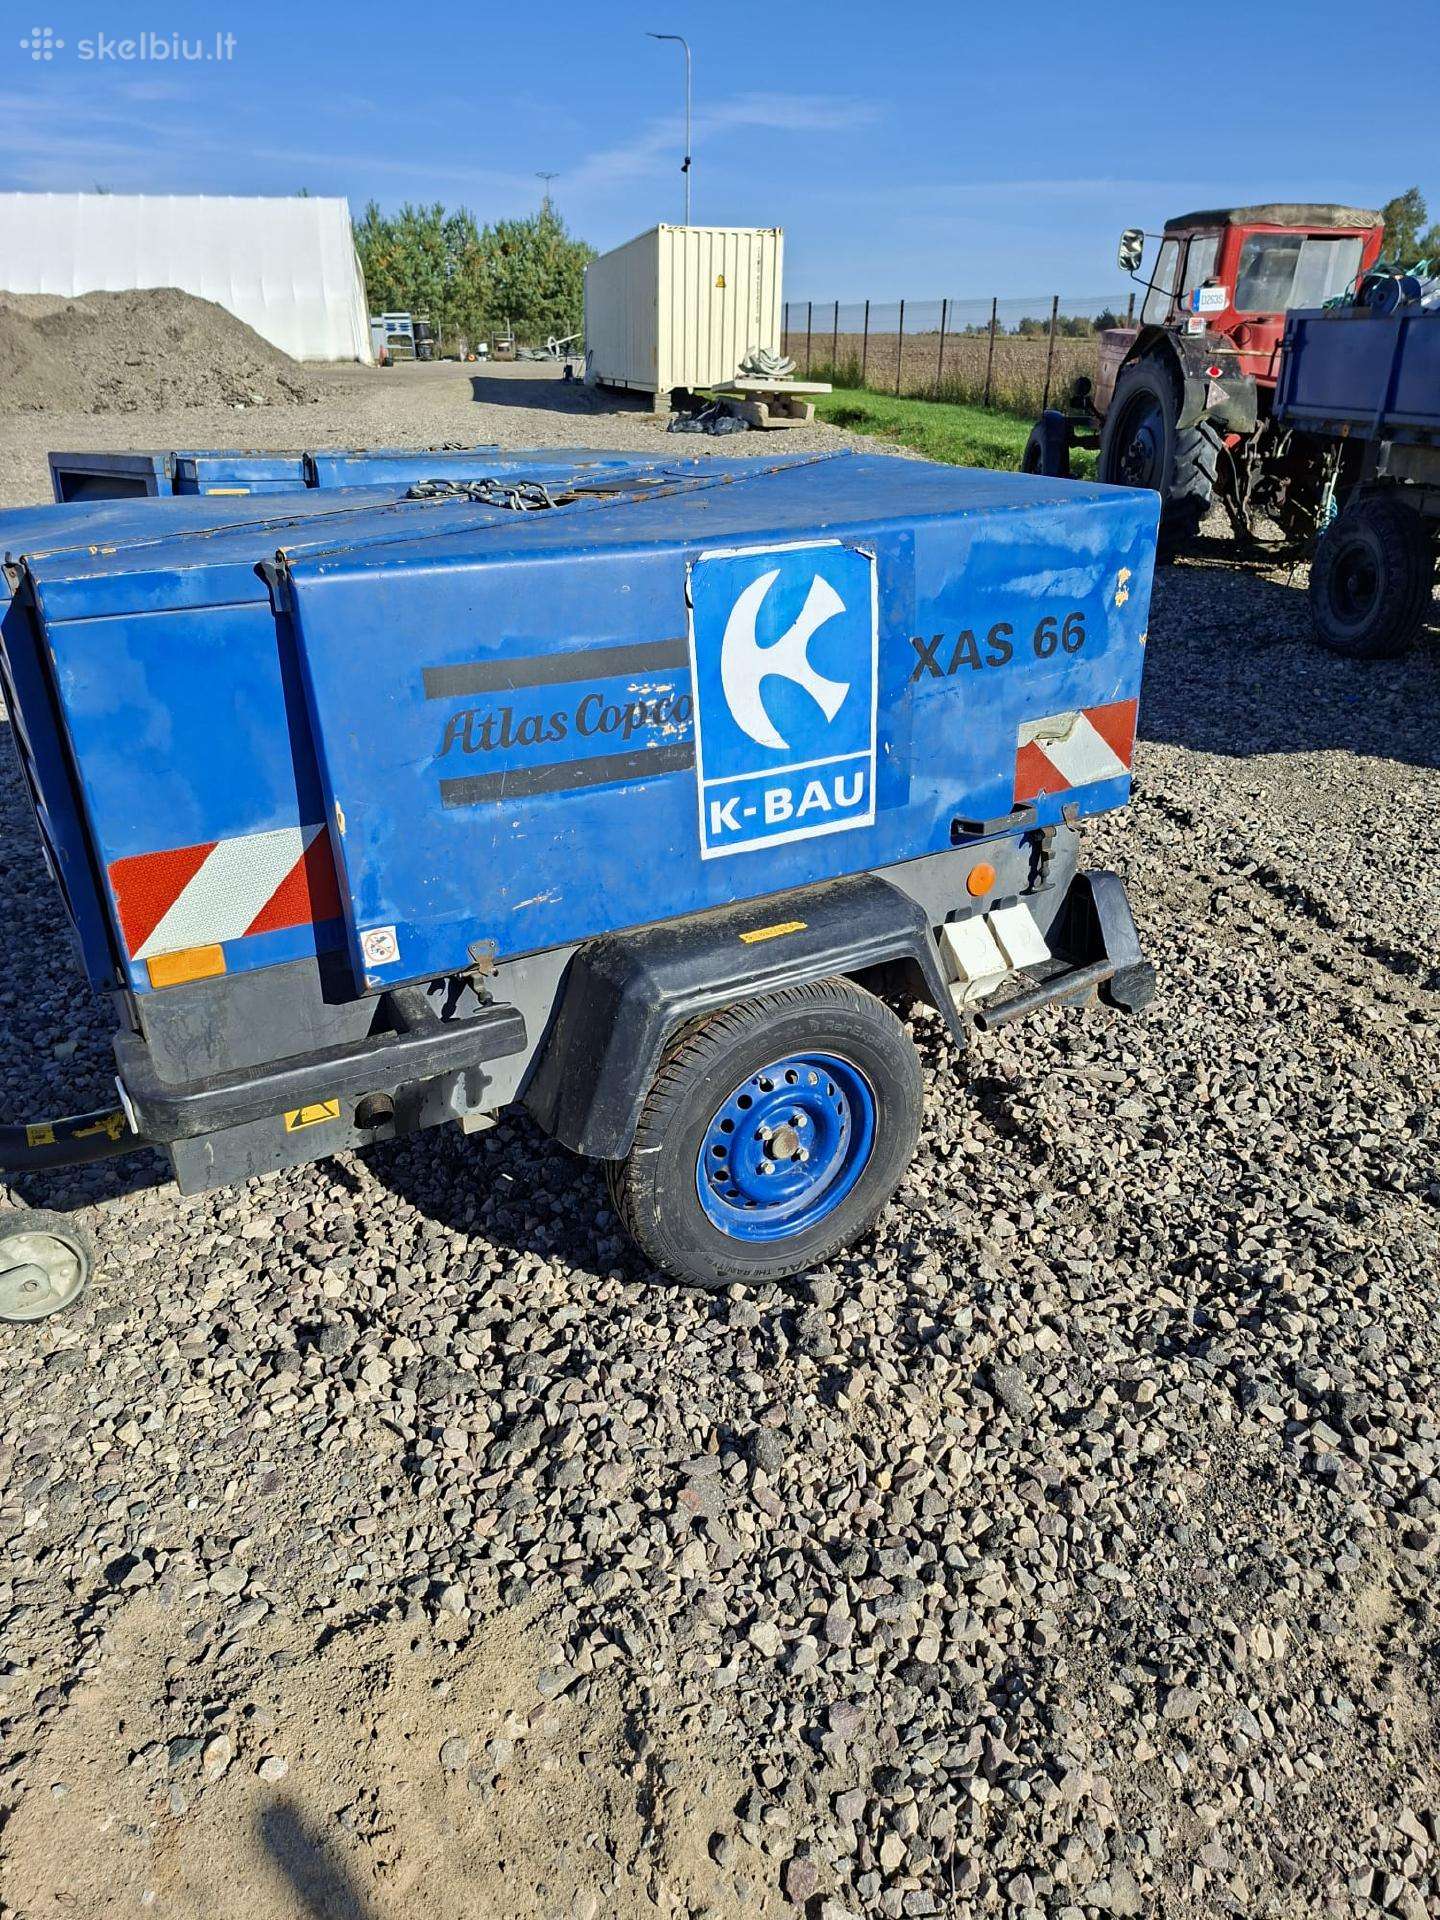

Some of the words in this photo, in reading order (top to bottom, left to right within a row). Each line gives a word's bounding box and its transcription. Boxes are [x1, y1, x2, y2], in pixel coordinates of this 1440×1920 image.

[909, 622, 1014, 682] XAS
[1033, 611, 1087, 660] 66
[436, 706, 568, 758] Atlas
[575, 693, 694, 741] Copco
[709, 771, 865, 835] K-BAU
